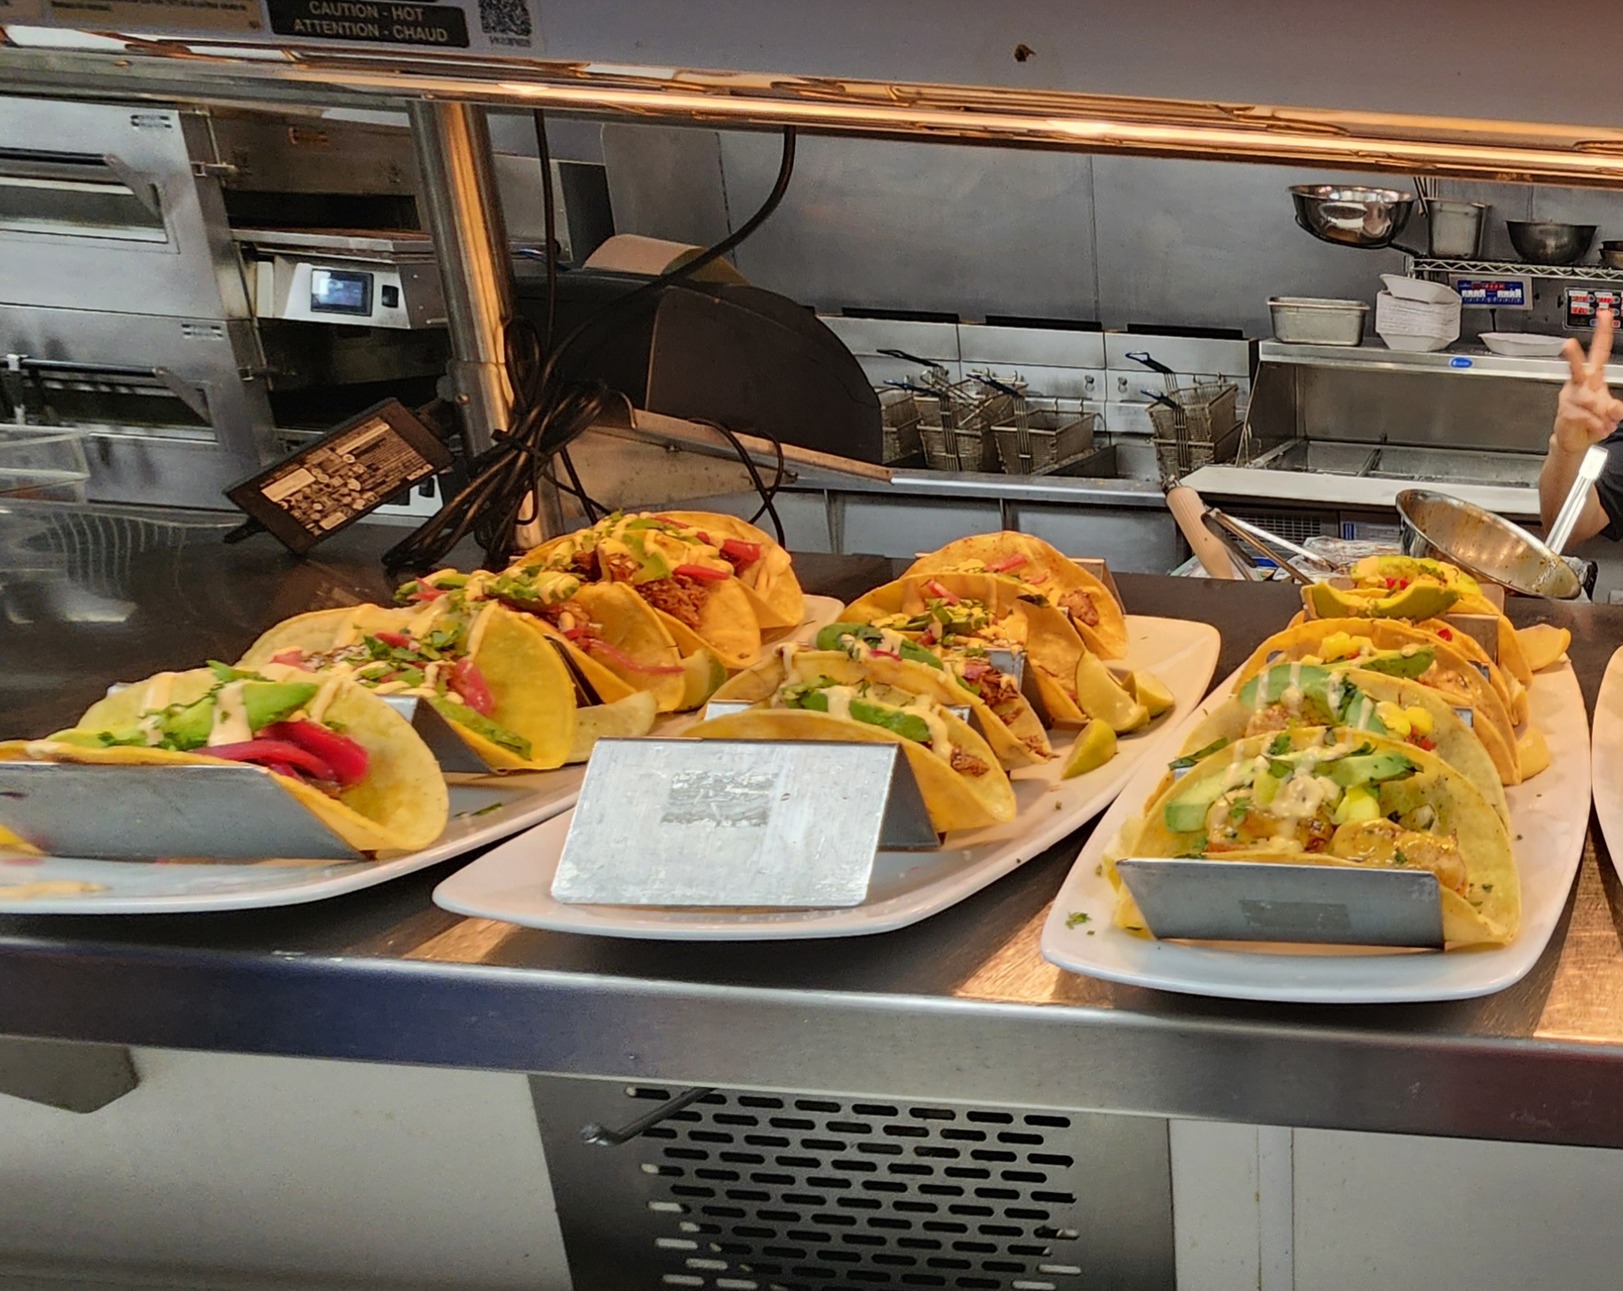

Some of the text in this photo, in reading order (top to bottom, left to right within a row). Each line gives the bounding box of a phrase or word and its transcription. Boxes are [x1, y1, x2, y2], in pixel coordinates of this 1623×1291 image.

[309, 0, 379, 19] CAUTION
[393, 6, 424, 22] HOT
[293, 18, 381, 38] ATTENTION
[393, 25, 448, 42] CHAUD
